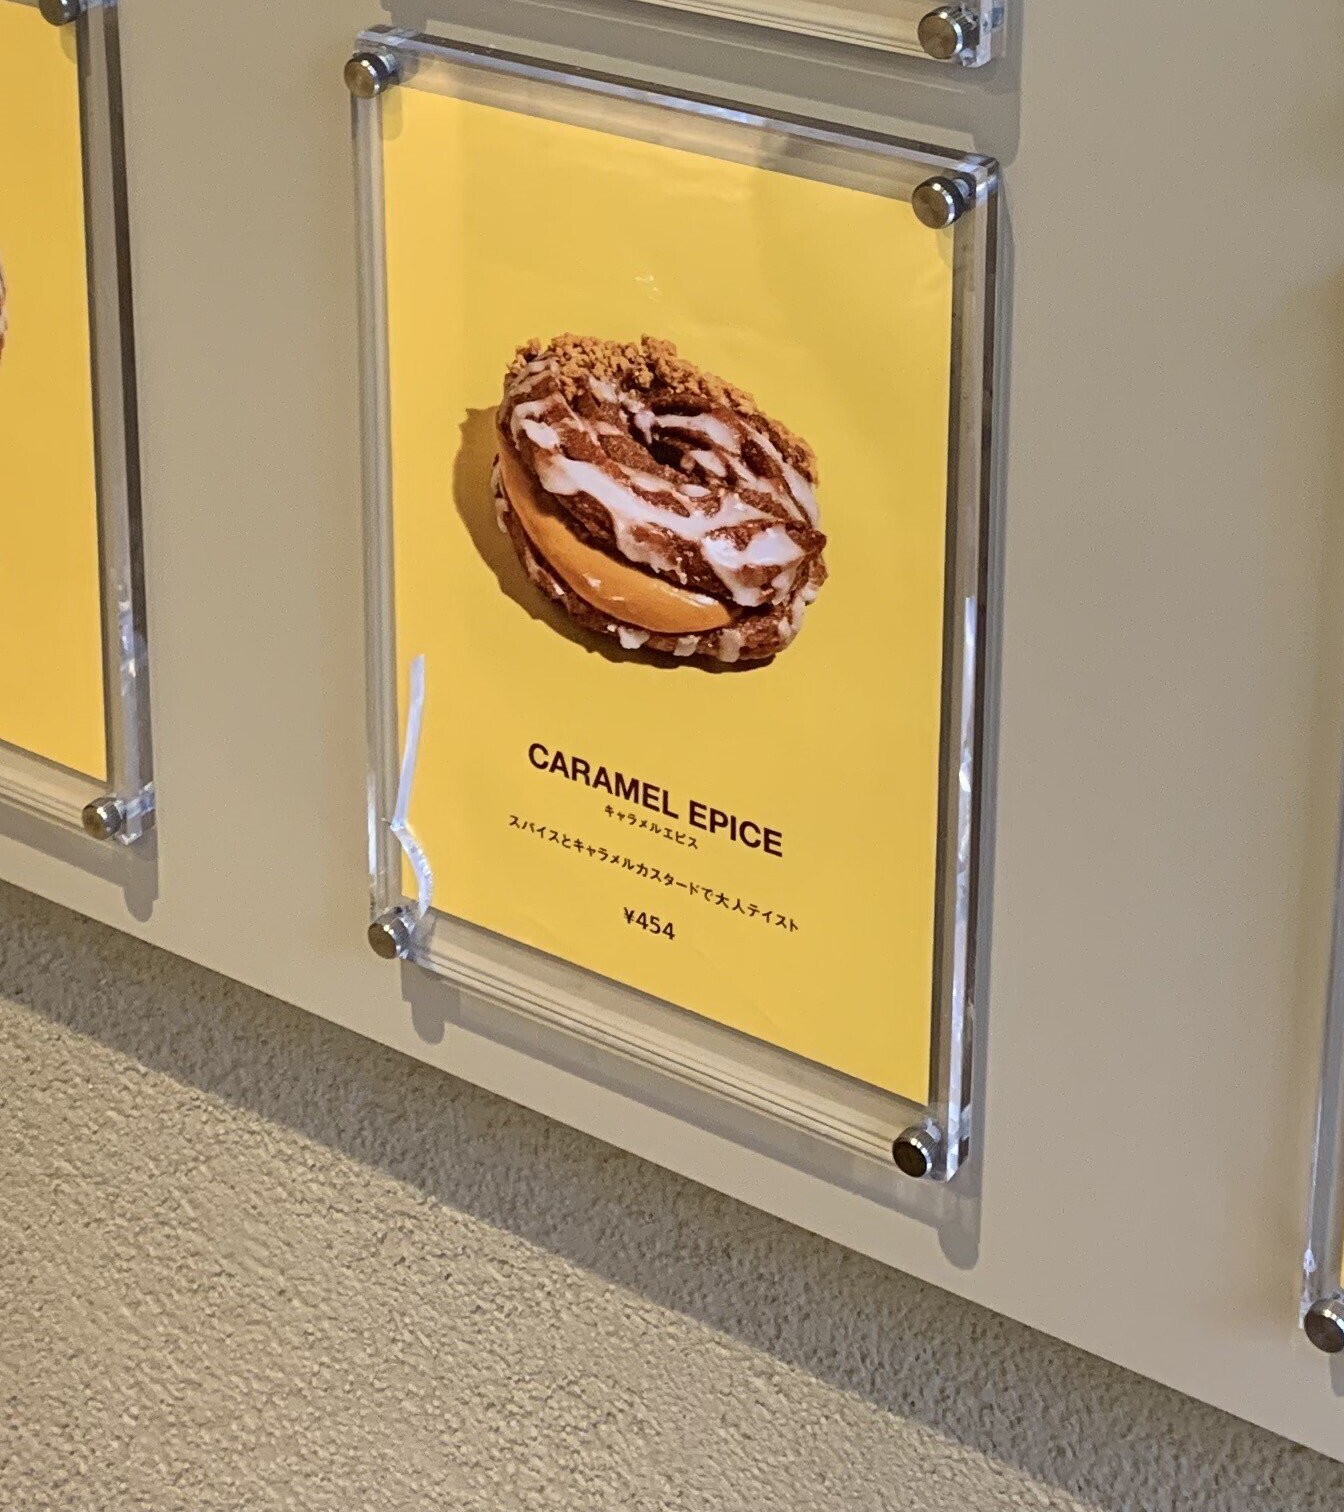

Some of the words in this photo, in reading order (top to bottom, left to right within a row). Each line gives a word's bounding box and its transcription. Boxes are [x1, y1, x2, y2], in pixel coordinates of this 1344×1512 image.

[528, 742, 679, 819] CARAMEL
[688, 799, 783, 858] EPICE
[604, 804, 699, 850] キャラメルエピス
[623, 907, 676, 940] ¥454
